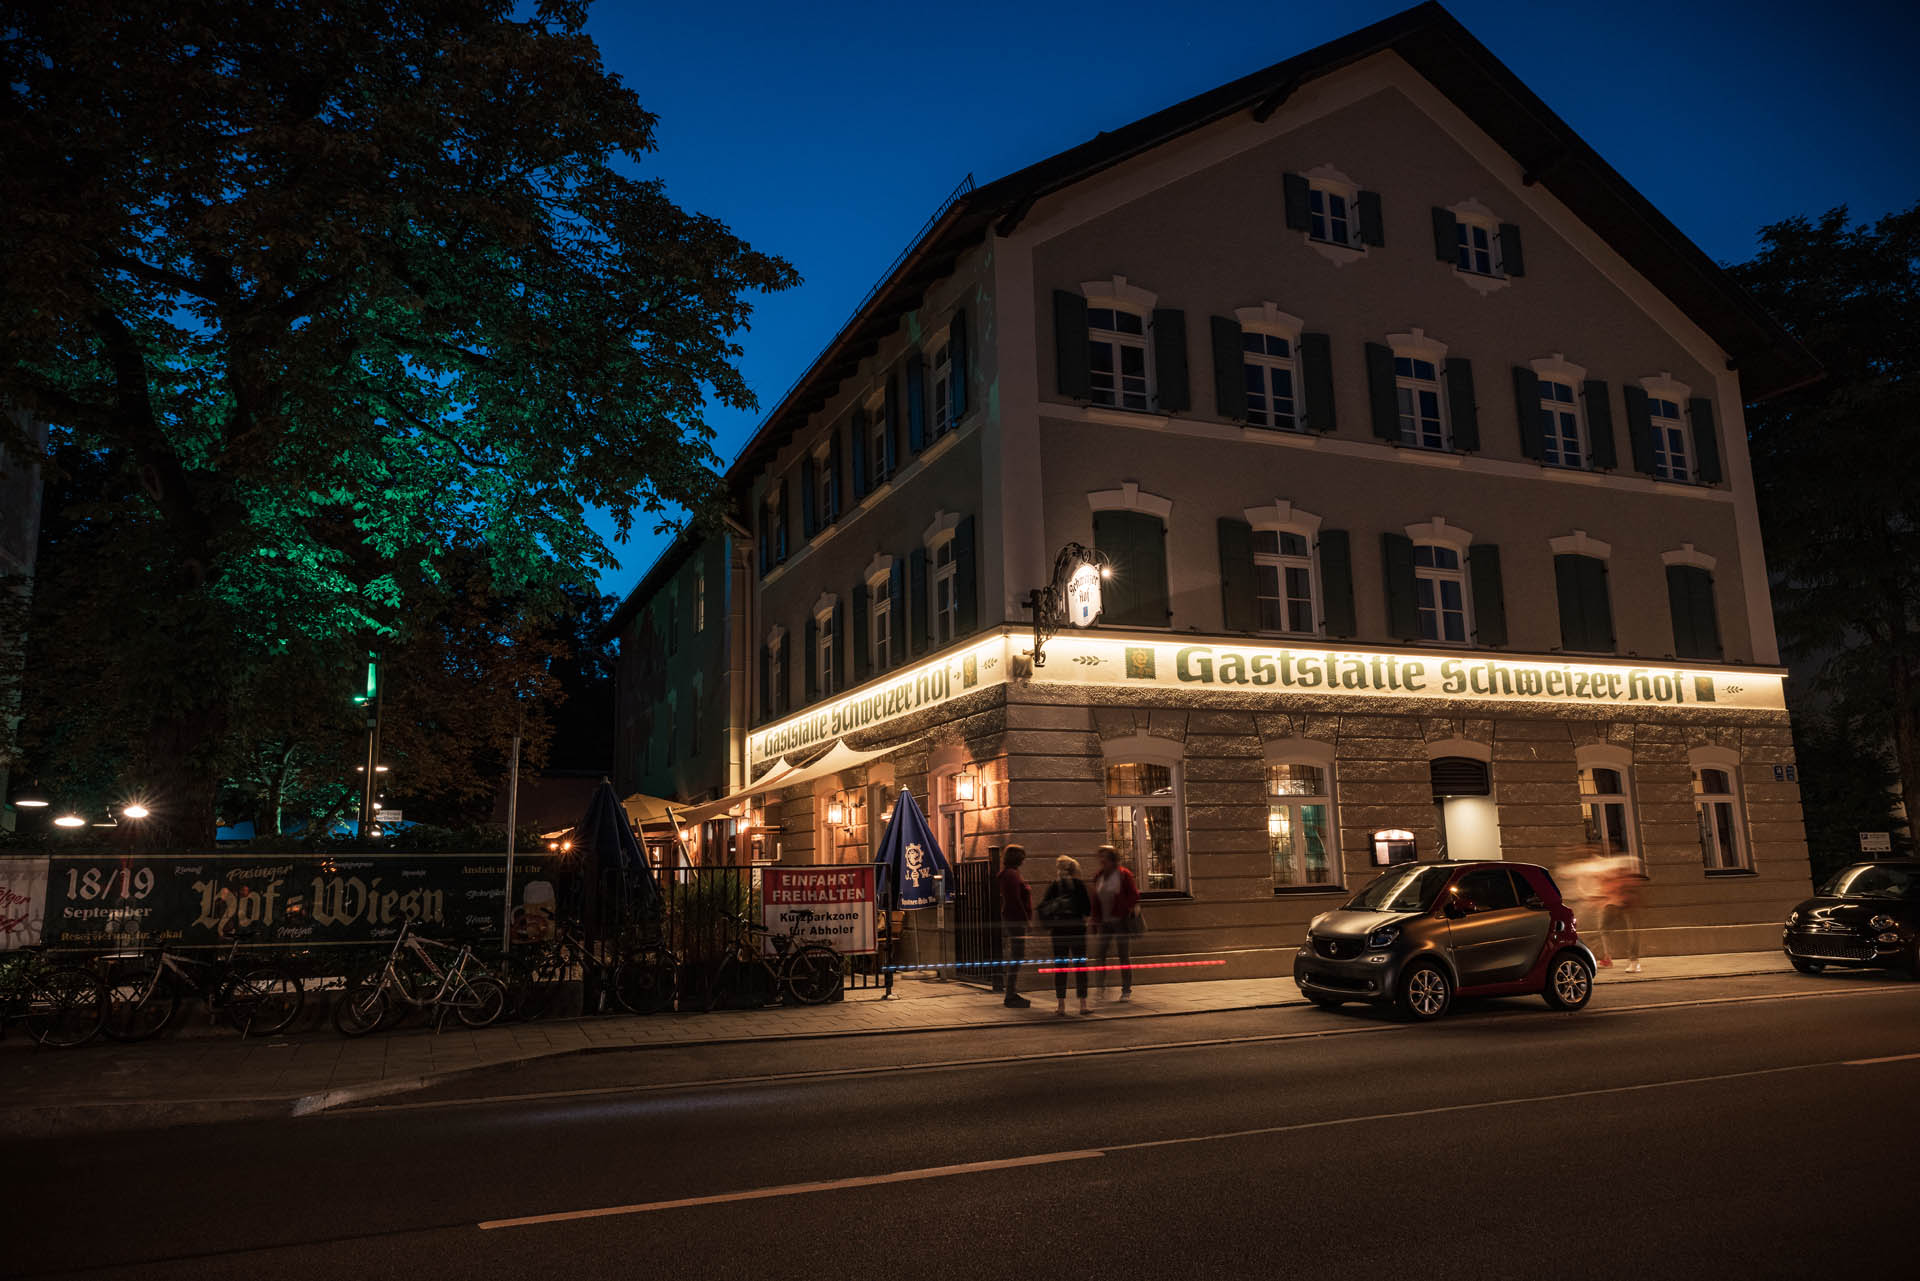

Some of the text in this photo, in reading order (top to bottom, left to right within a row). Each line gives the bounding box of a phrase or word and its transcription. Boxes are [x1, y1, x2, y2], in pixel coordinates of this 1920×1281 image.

[1176, 646, 1427, 691] Gaststätte
[1441, 659, 1623, 698] Schweizer
[831, 681, 913, 736] Schweizer
[65, 866, 155, 901] 18/19
[782, 873, 856, 886] EINFAHRT
[773, 888, 865, 902] FREIHALTEN
[64, 906, 152, 921] September
[780, 911, 859, 923] Kurzparkzone
[810, 924, 854, 936] Abholer
